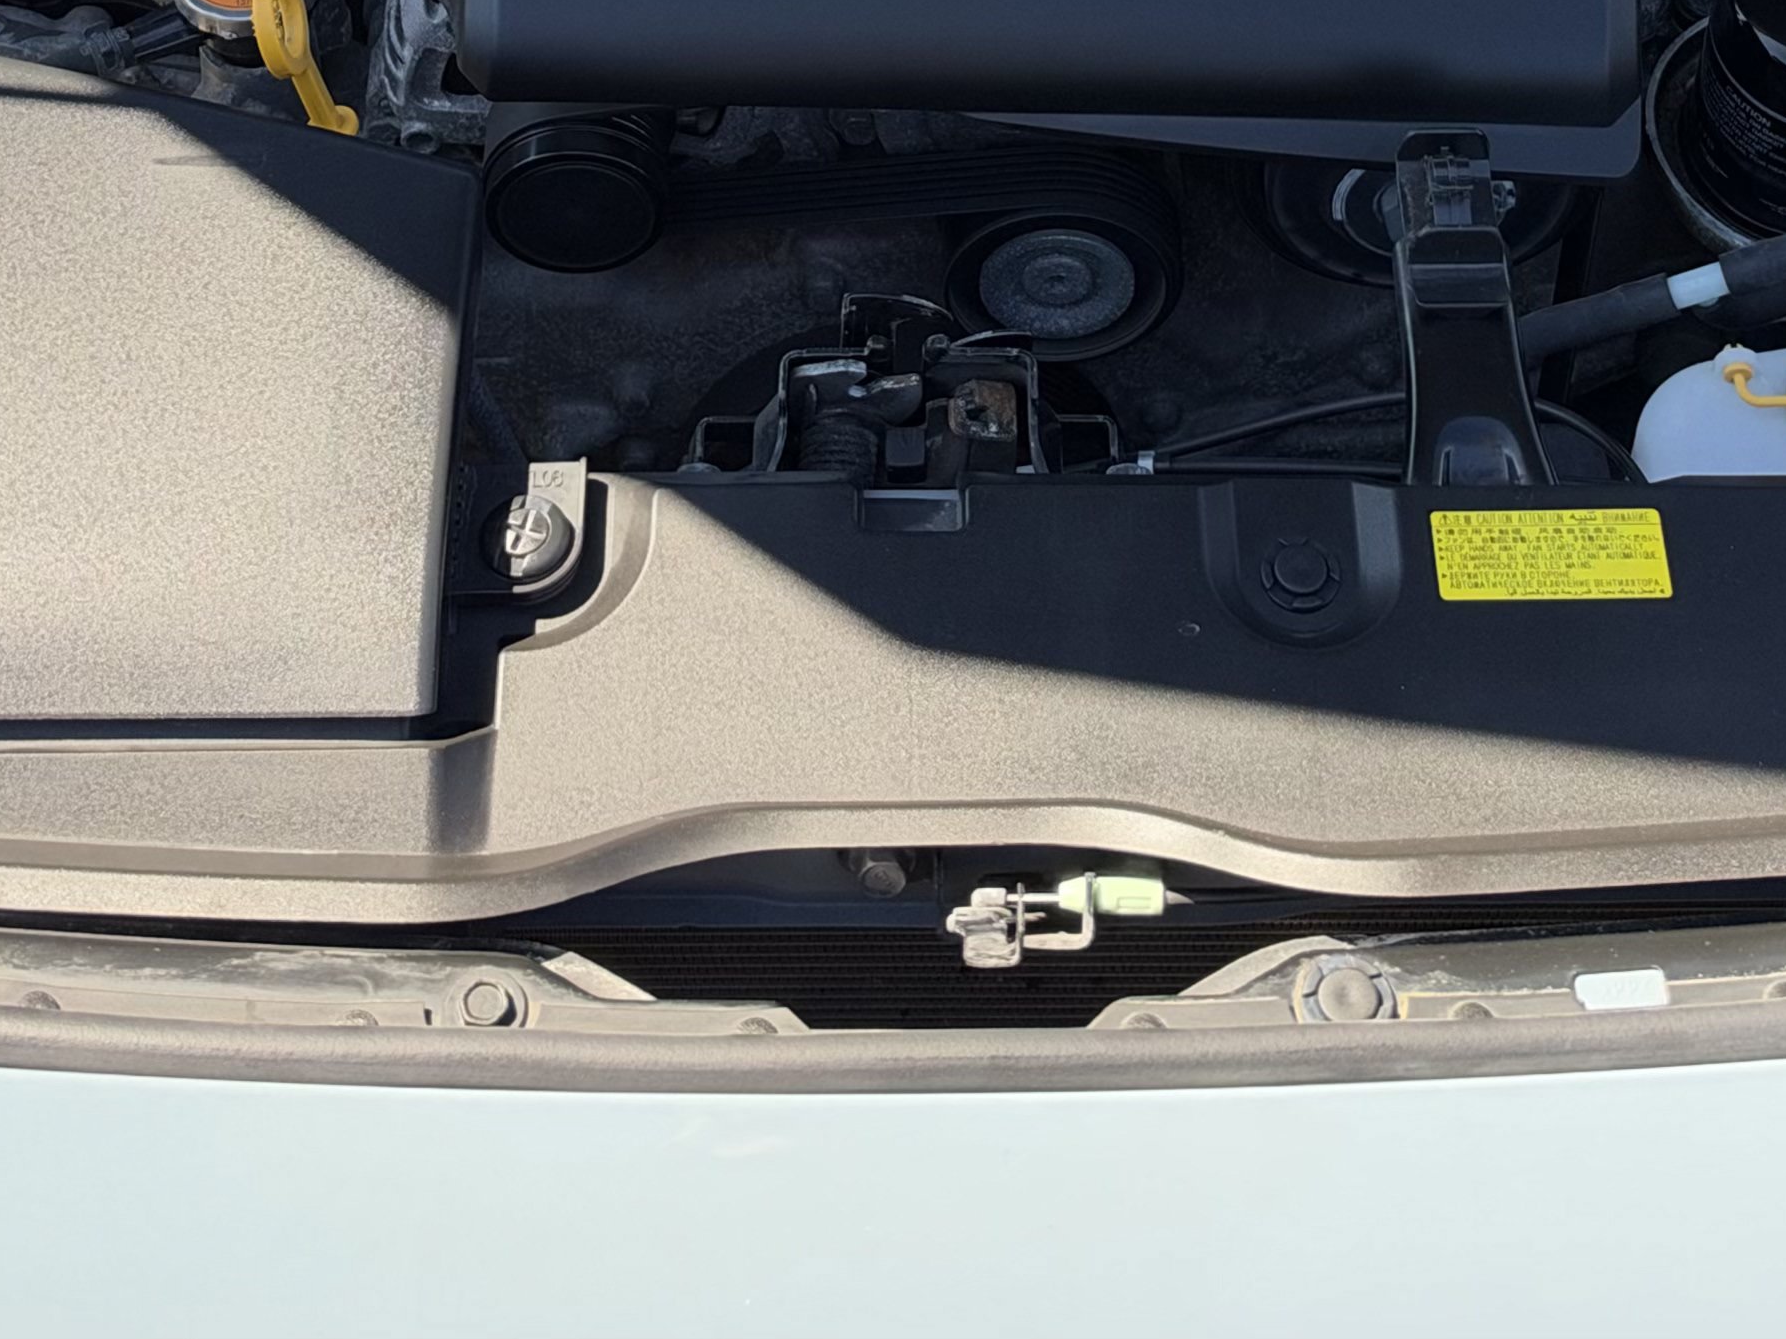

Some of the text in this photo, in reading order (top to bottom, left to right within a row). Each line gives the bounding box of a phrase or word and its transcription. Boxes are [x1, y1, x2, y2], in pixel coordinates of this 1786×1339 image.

[1726, 85, 1772, 128] CAUTION
[1476, 513, 1565, 524] CAUTION ATTENTION
